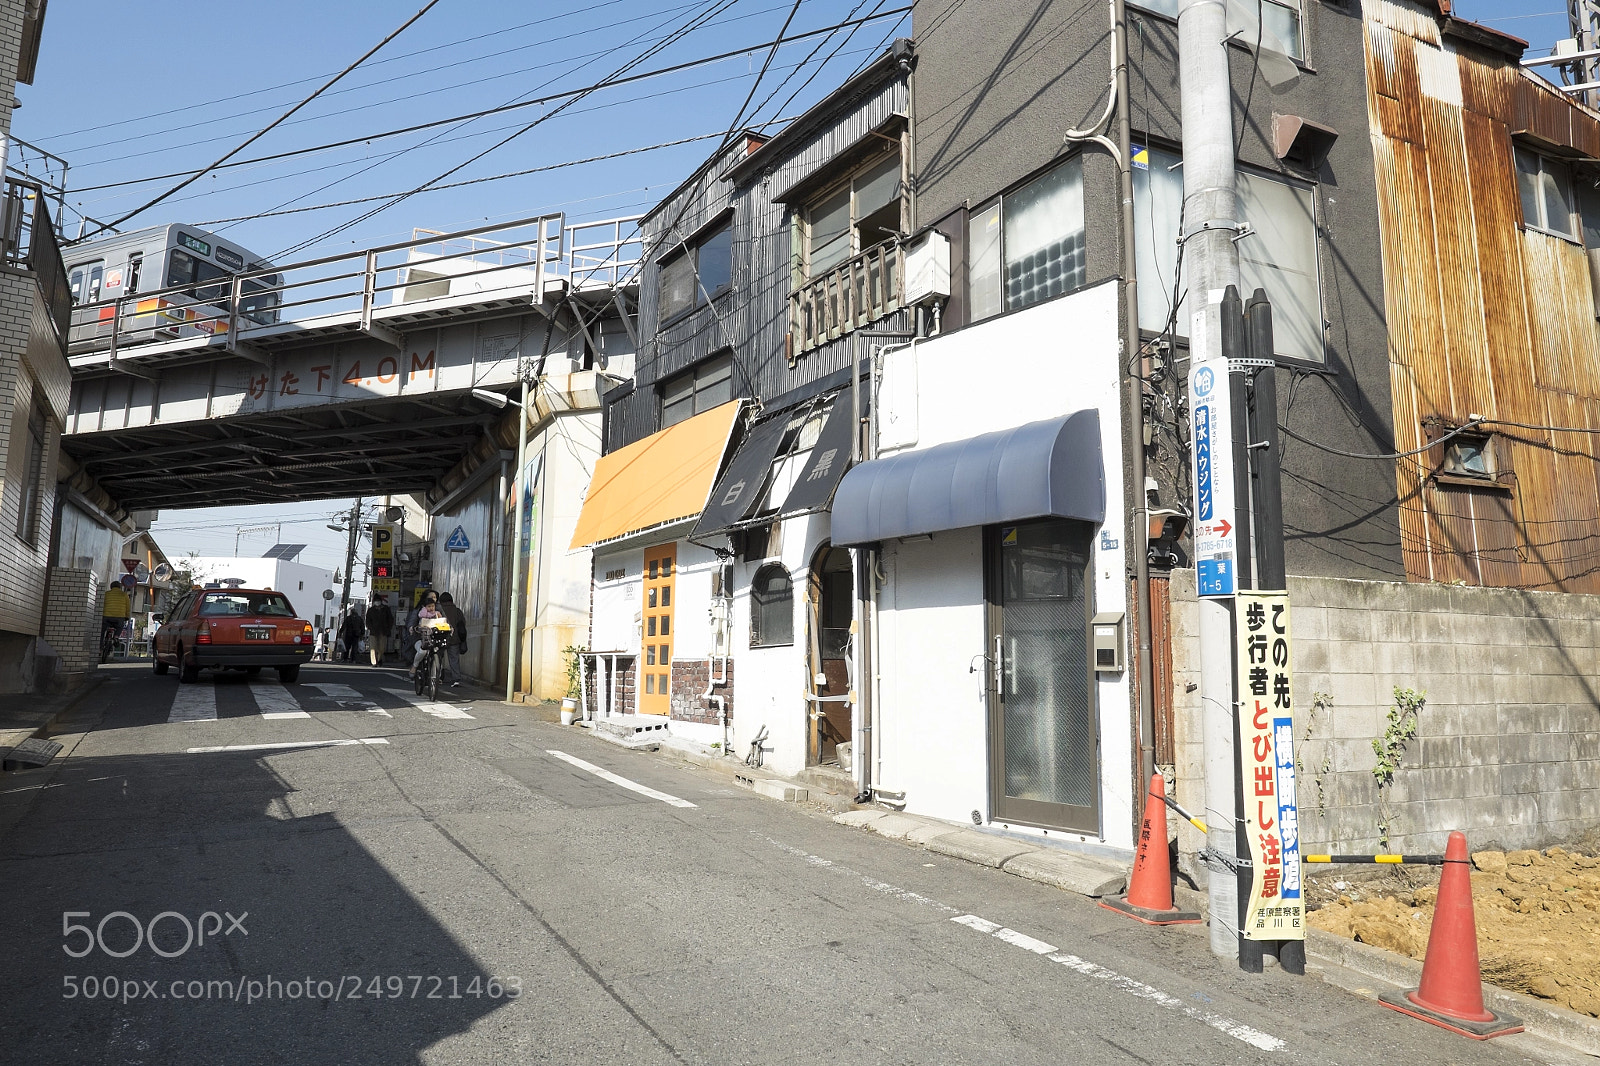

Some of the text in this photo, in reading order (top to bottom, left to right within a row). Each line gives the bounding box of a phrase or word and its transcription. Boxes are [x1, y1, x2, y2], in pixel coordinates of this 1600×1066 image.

[806, 448, 838, 482] 黒
[1195, 409, 1211, 518] 清水ハウジング
[721, 478, 747, 506] 白
[376, 530, 390, 548] P
[1101, 540, 1118, 550] 5-15
[377, 566, 388, 577] 満
[1200, 563, 1226, 576] 二葉
[1202, 580, 1222, 592] 1-5
[1246, 601, 1281, 899] 歩行者とび出し注意
[1271, 603, 1301, 892] この先 横断歩道
[1256, 918, 1301, 928] 品川区
